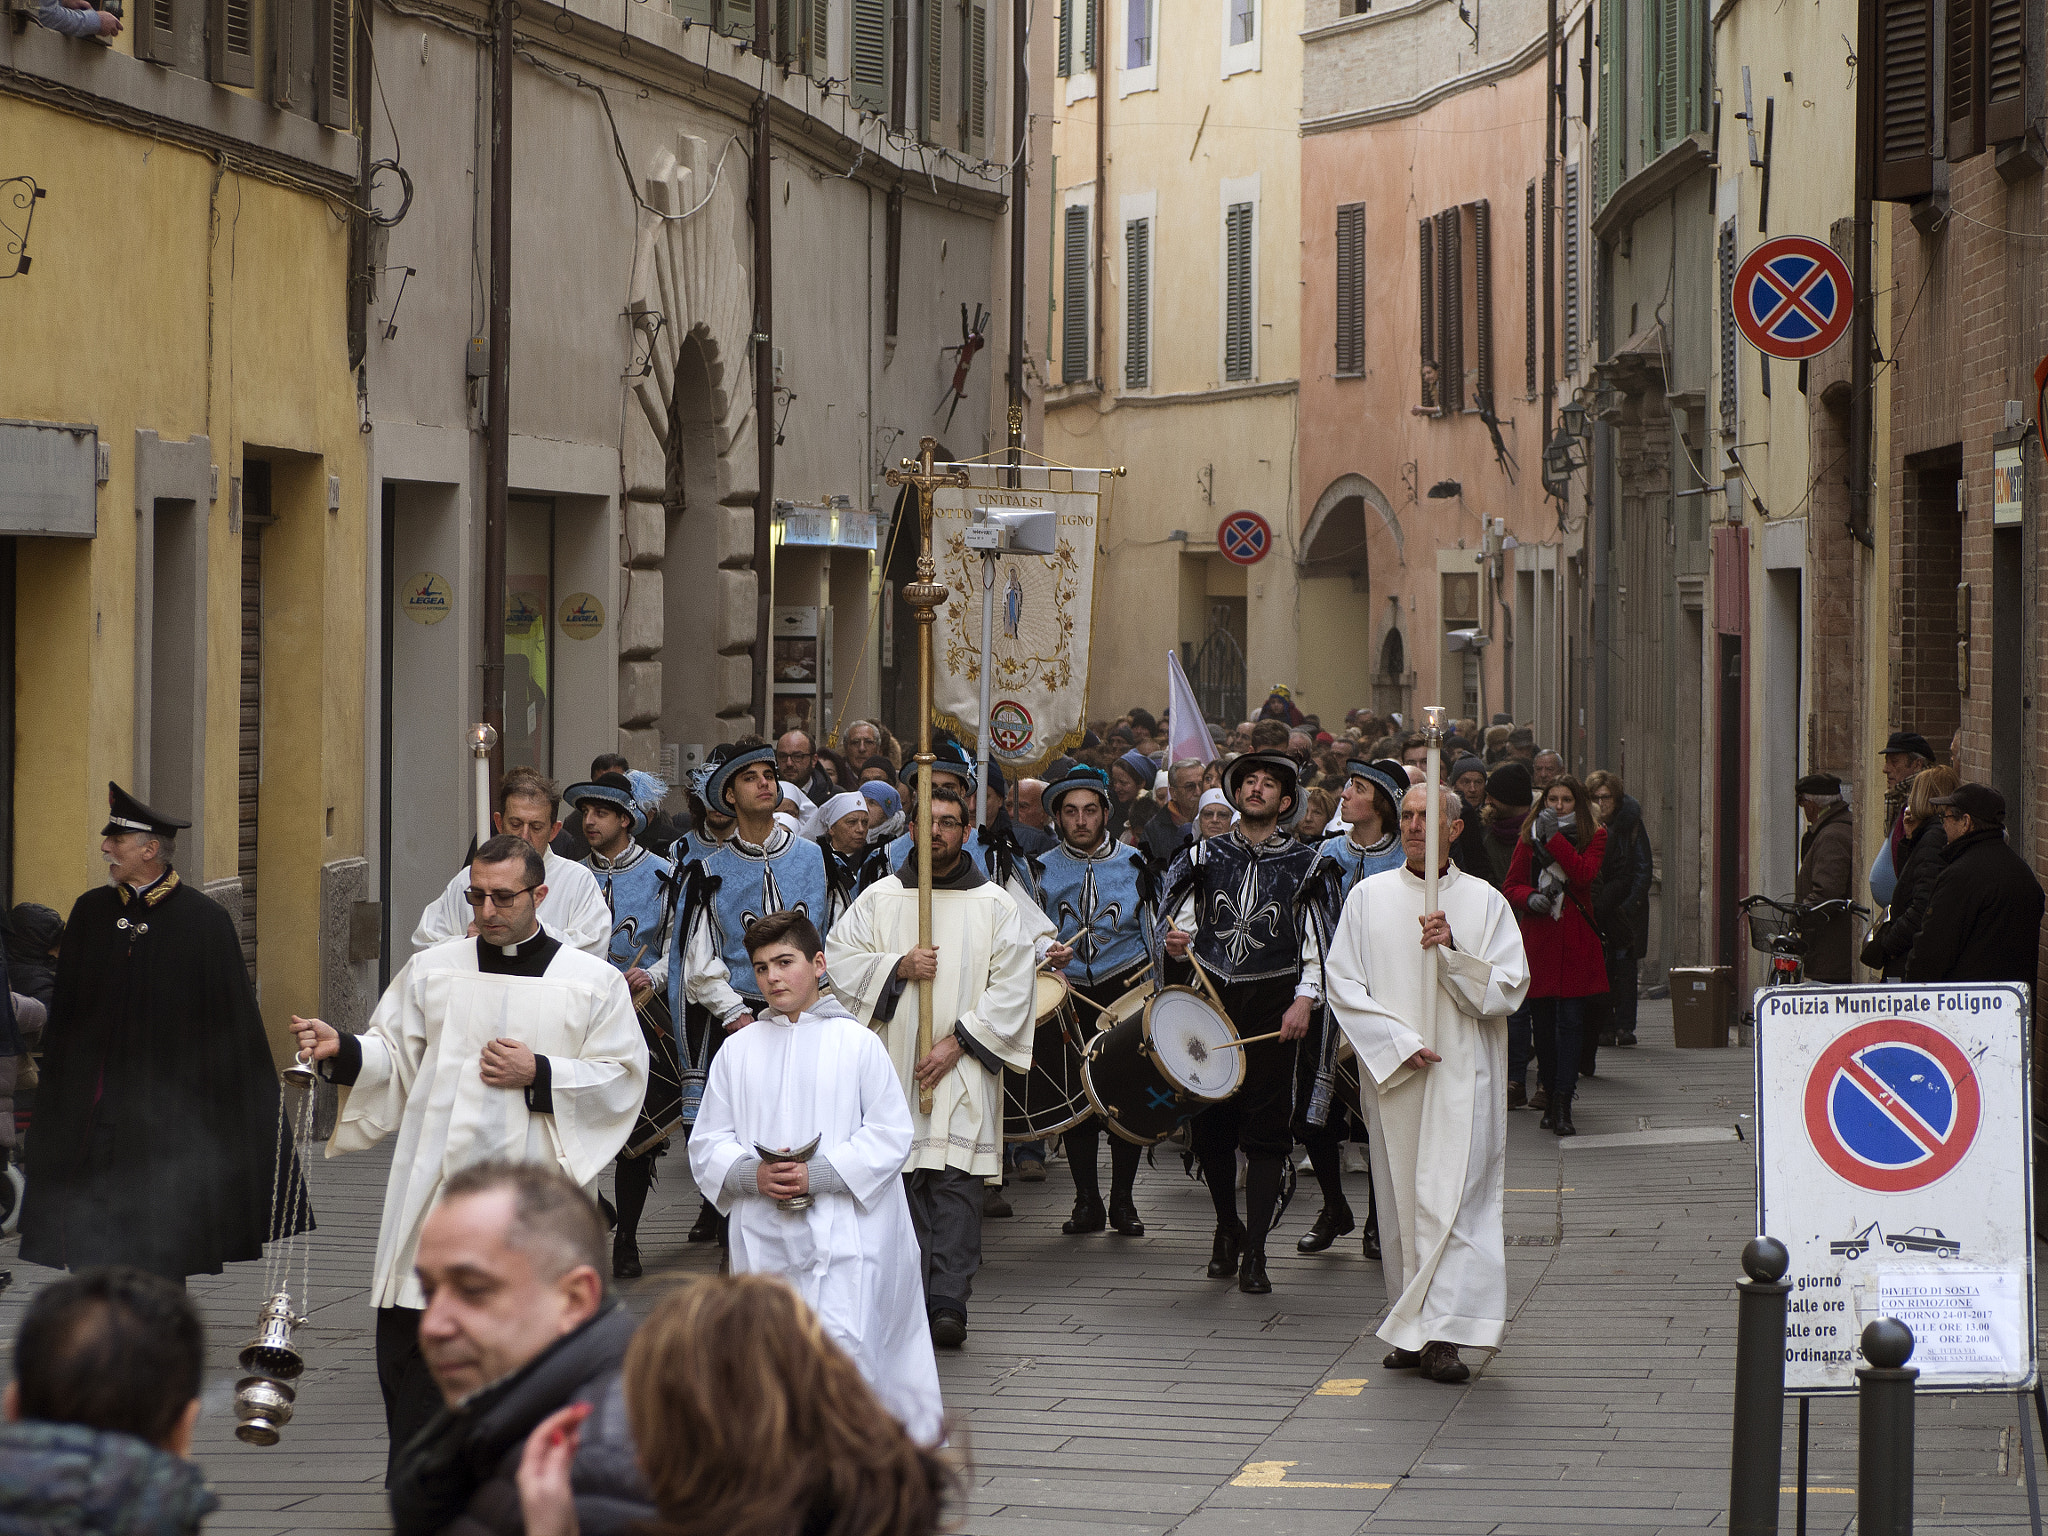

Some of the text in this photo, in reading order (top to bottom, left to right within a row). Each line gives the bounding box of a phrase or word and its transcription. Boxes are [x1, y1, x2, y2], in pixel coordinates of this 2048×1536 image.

[978, 494, 1043, 508] UNITALSI
[409, 597, 445, 605] LEGEA
[566, 614, 599, 623] LEGEA
[1770, 993, 2003, 1017] Polizia Municipale Foligno
[1798, 1274, 1842, 1292] giorno
[1881, 1286, 1980, 1296] DIVIETO DI SOSTA
[1823, 1301, 1845, 1312] ore
[1881, 1298, 1973, 1308] CON RIMOZIONE
[1895, 1311, 1940, 1320] GIORNO
[1943, 1310, 1993, 1320] 24-01-2017
[1815, 1325, 1837, 1337] ore
[1939, 1323, 1963, 1332] ORE
[1966, 1322, 1990, 1332] 13.00
[1939, 1335, 1963, 1344] ORE
[1965, 1334, 1990, 1344] 20.00
[1785, 1347, 1852, 1363] Ordinanza
